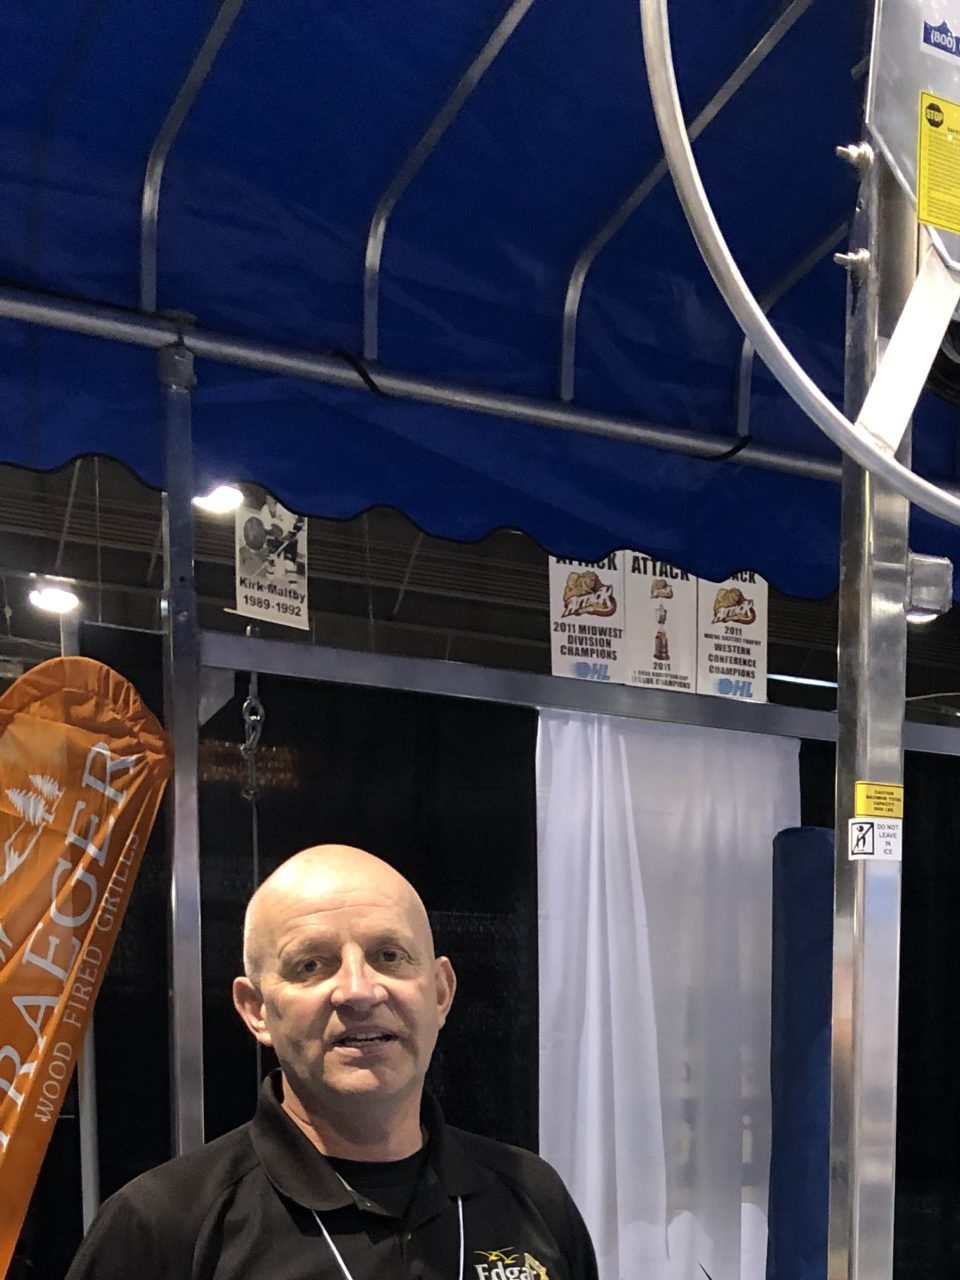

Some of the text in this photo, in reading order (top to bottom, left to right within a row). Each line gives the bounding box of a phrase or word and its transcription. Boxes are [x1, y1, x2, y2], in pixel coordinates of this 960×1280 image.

[930, 29, 957, 53] (800)
[926, 110, 944, 123] STOP
[240, 577, 305, 604] Kirk Maltby
[243, 594, 302, 617] 1989-1992
[553, 621, 623, 639] 2011 MIDWEST
[724, 625, 742, 636] 2011
[567, 634, 612, 649] DIVISION
[714, 643, 751, 656] WESTERN
[560, 645, 617, 661] CHAMPIONS
[708, 653, 756, 668] CONFERENCE
[708, 664, 756, 680] CHAMPIONS
[0, 742, 137, 1152] RAEGER
[34, 832, 140, 1122] WOOD FIRED GRILLS
